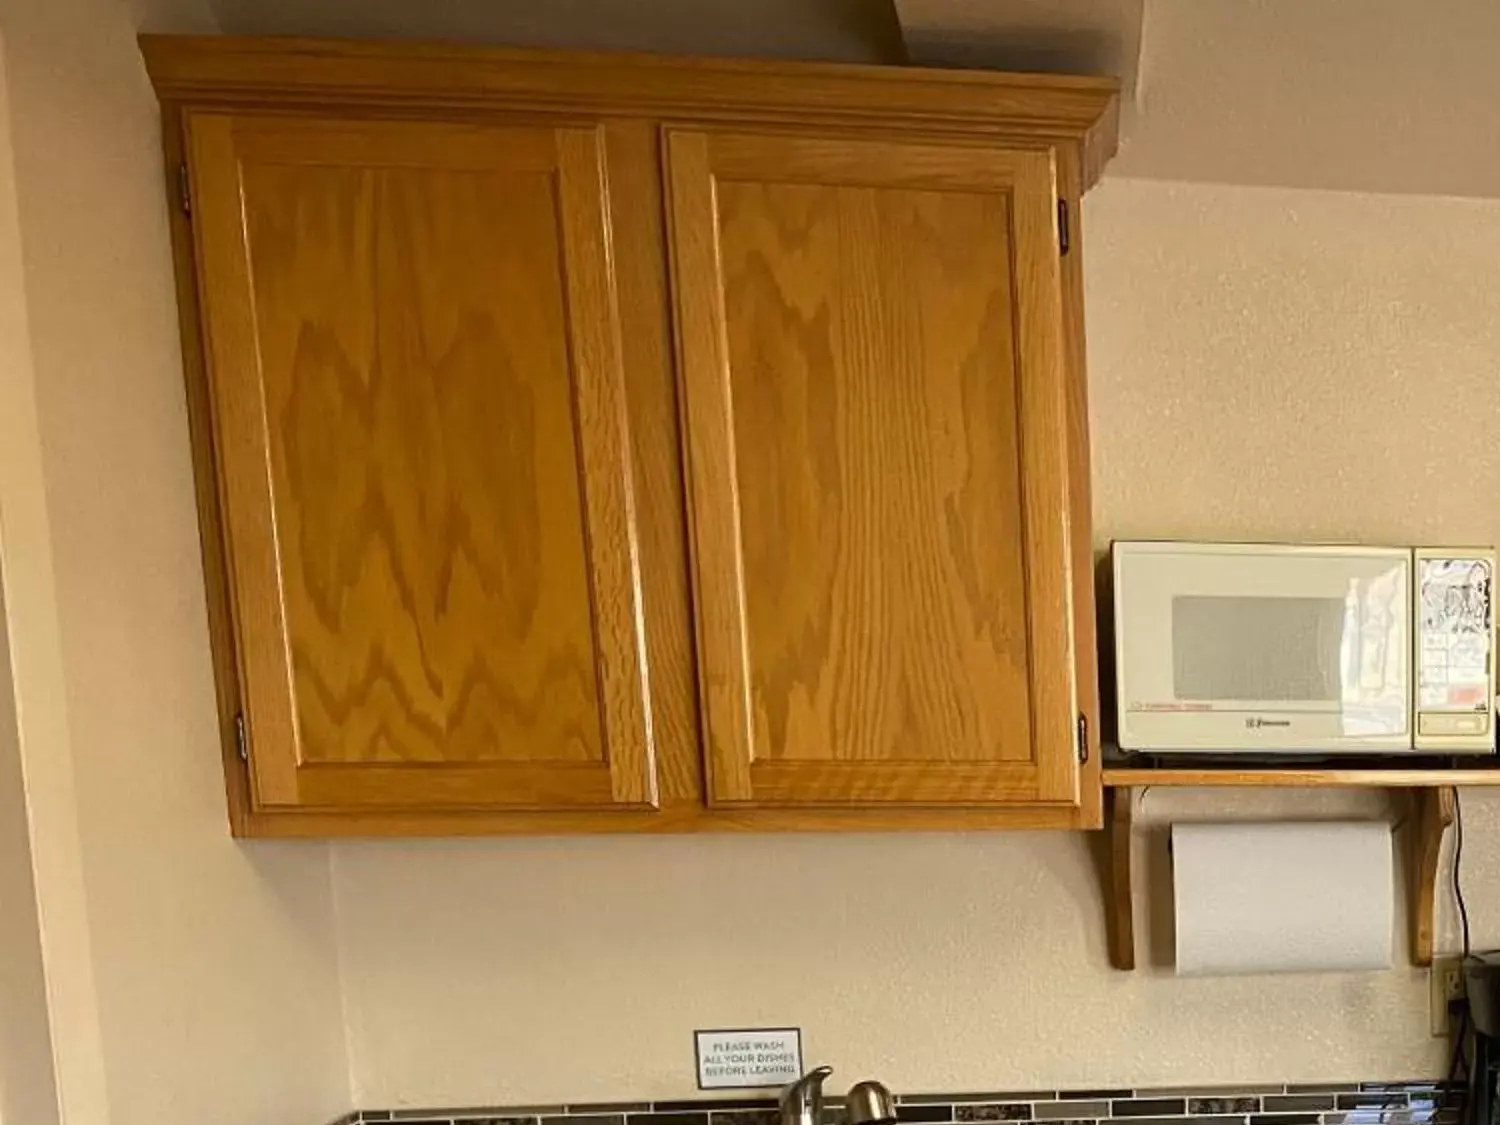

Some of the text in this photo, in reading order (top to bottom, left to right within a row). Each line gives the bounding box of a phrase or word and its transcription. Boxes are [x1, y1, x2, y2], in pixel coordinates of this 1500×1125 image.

[713, 1040, 784, 1052] PLEASE WASH
[703, 1053, 795, 1064] ALL YOUR DISHES
[705, 1065, 795, 1077] BEFORE LEAVING
